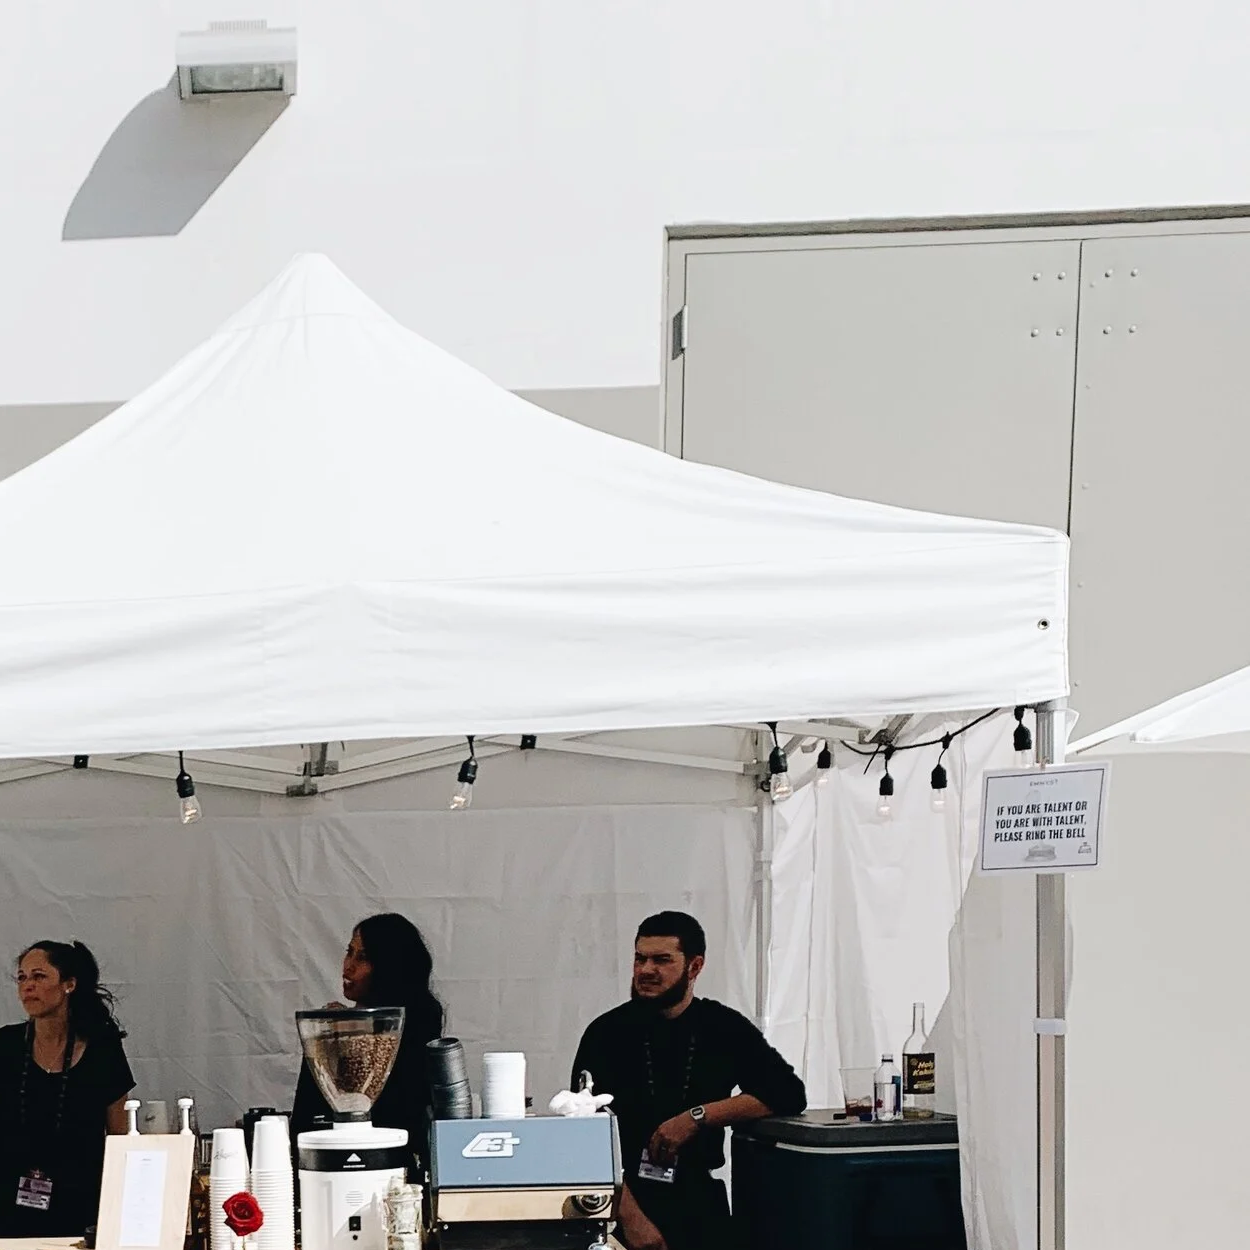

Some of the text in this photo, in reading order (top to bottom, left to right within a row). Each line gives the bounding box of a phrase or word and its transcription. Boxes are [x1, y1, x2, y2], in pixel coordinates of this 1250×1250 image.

[997, 801, 1088, 816] IF YOU ARE TALENT OR
[995, 819, 1012, 829] YOU
[1014, 818, 1030, 828] ARE
[1032, 816, 1053, 827] WITH
[994, 828, 1086, 842] PLEASE RING THE BELL
